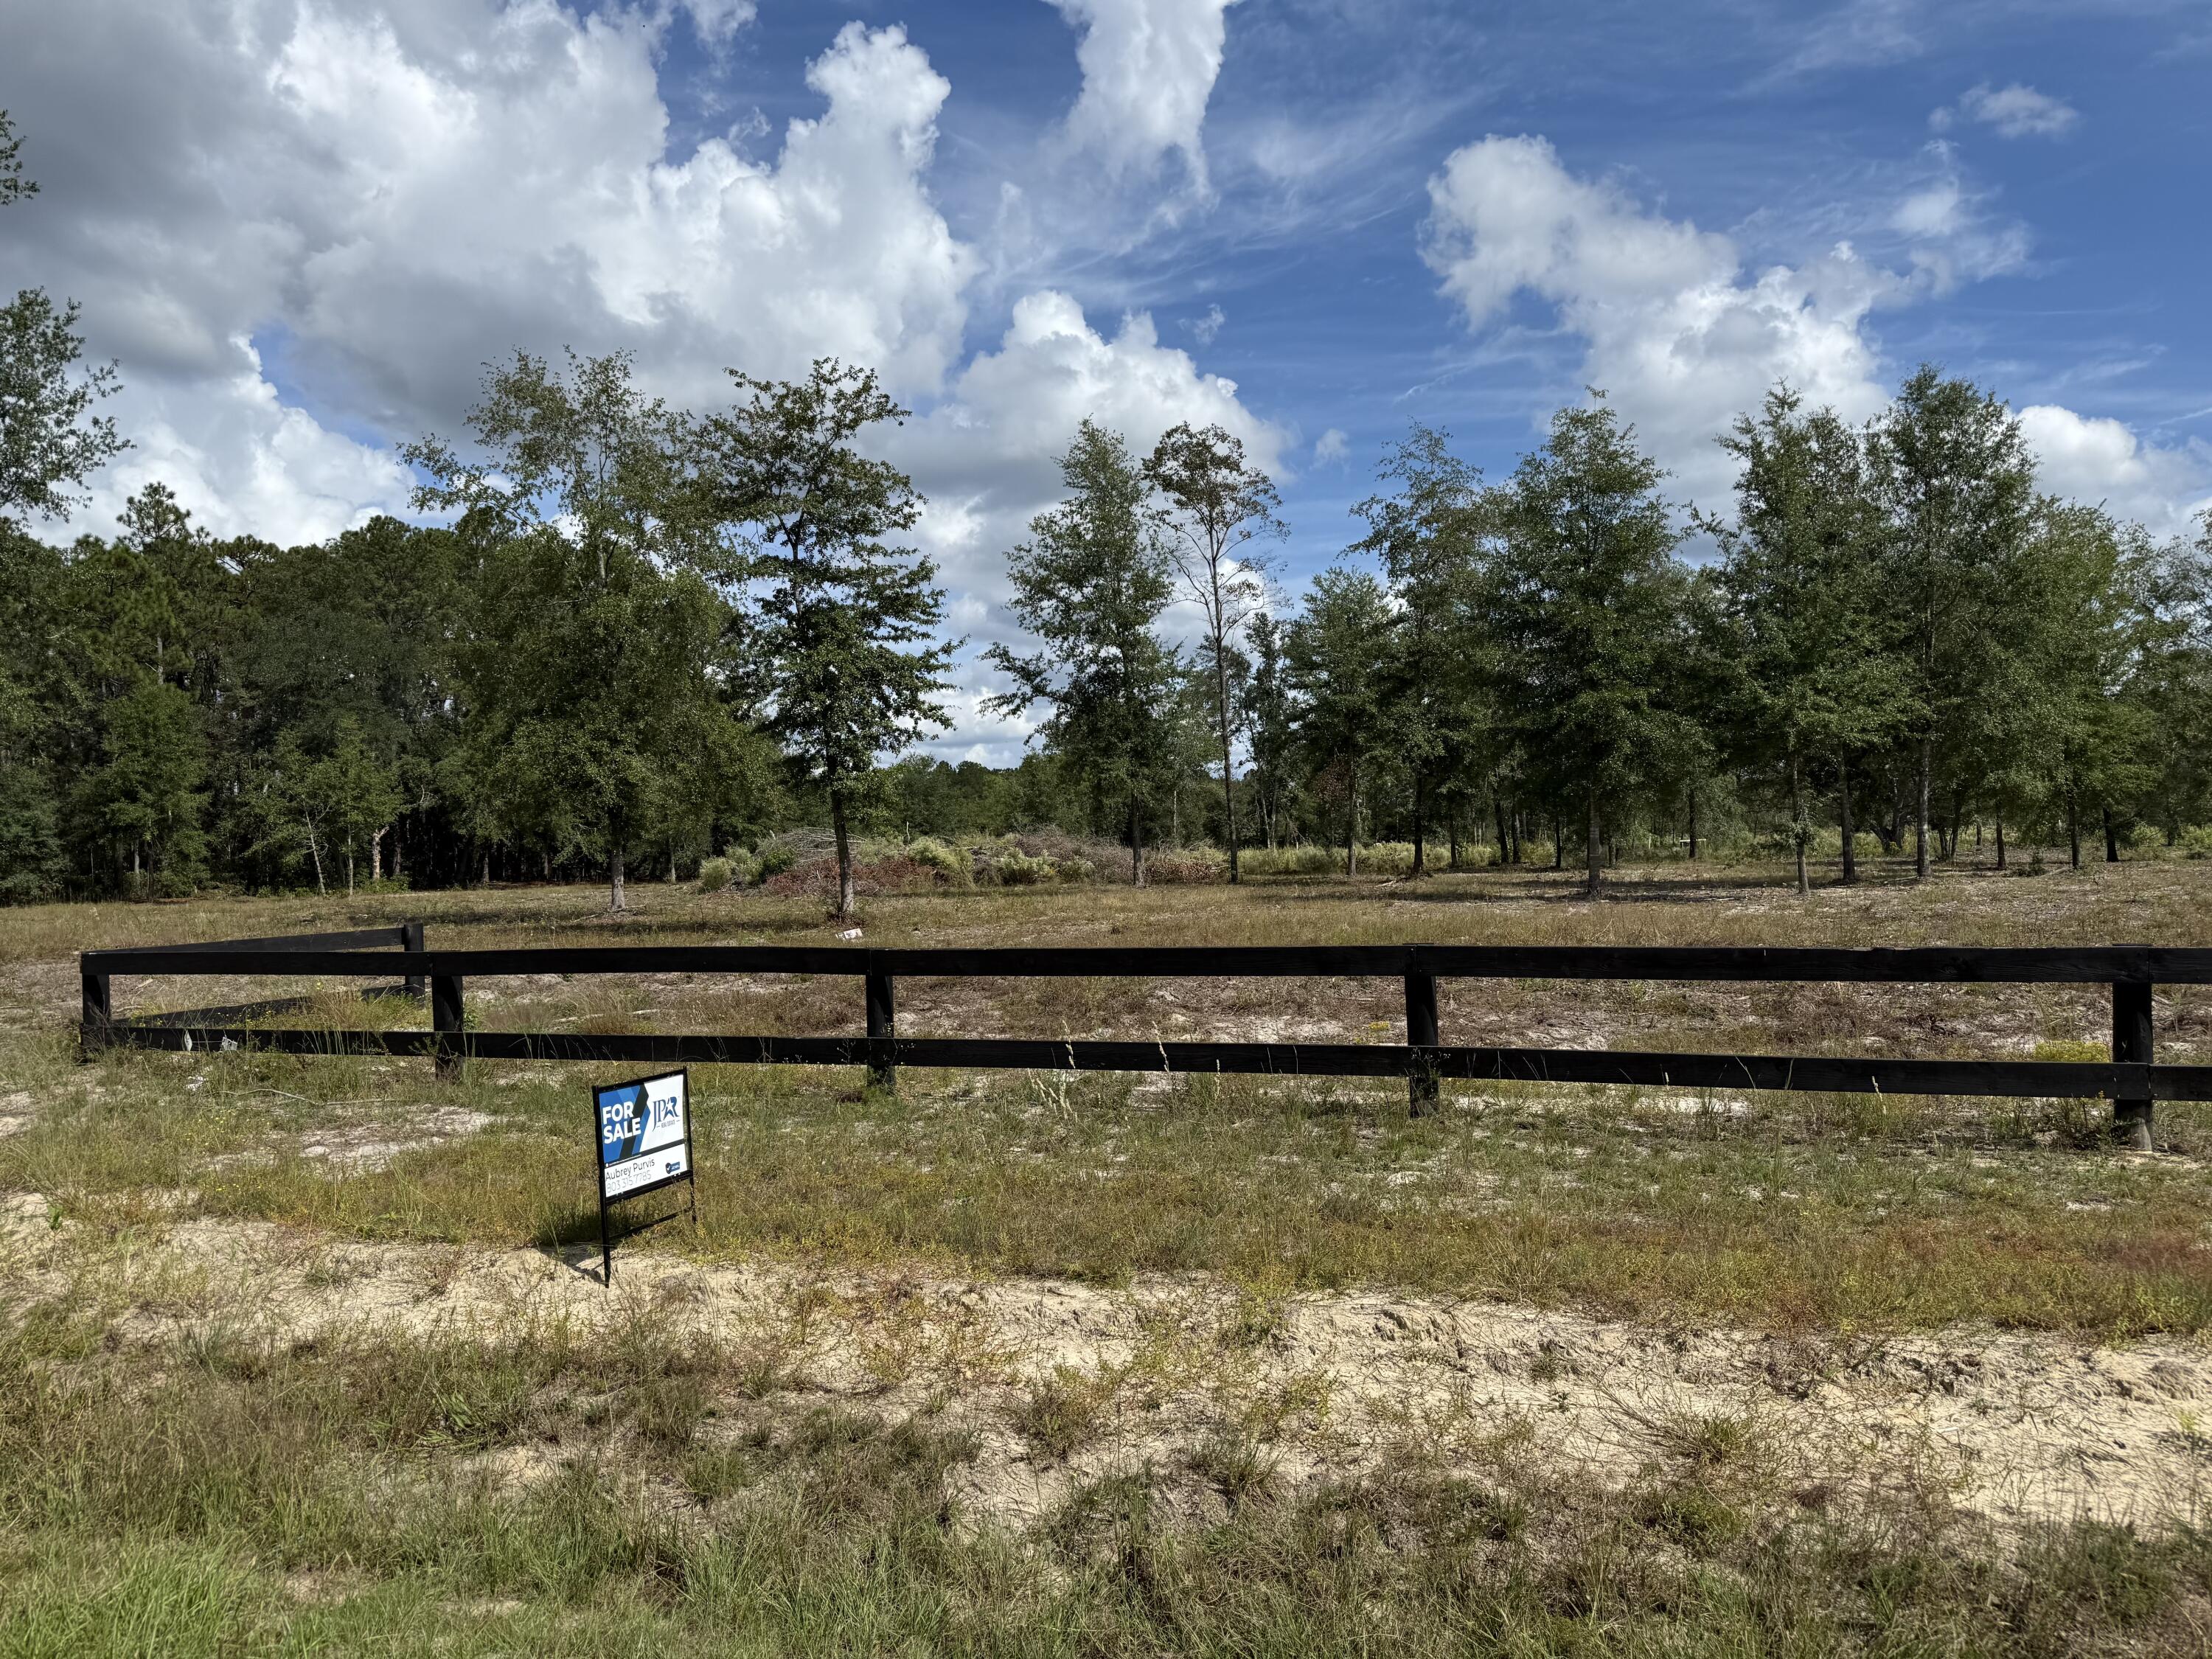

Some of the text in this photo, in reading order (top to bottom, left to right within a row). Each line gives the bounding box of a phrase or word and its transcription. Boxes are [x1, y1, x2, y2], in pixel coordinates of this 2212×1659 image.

[602, 1101, 634, 1124] FOR
[603, 1117, 641, 1144] SALE
[605, 1166, 631, 1181] Aubrey
[633, 1158, 655, 1172] Purvis
[606, 1180, 620, 1193] 803
